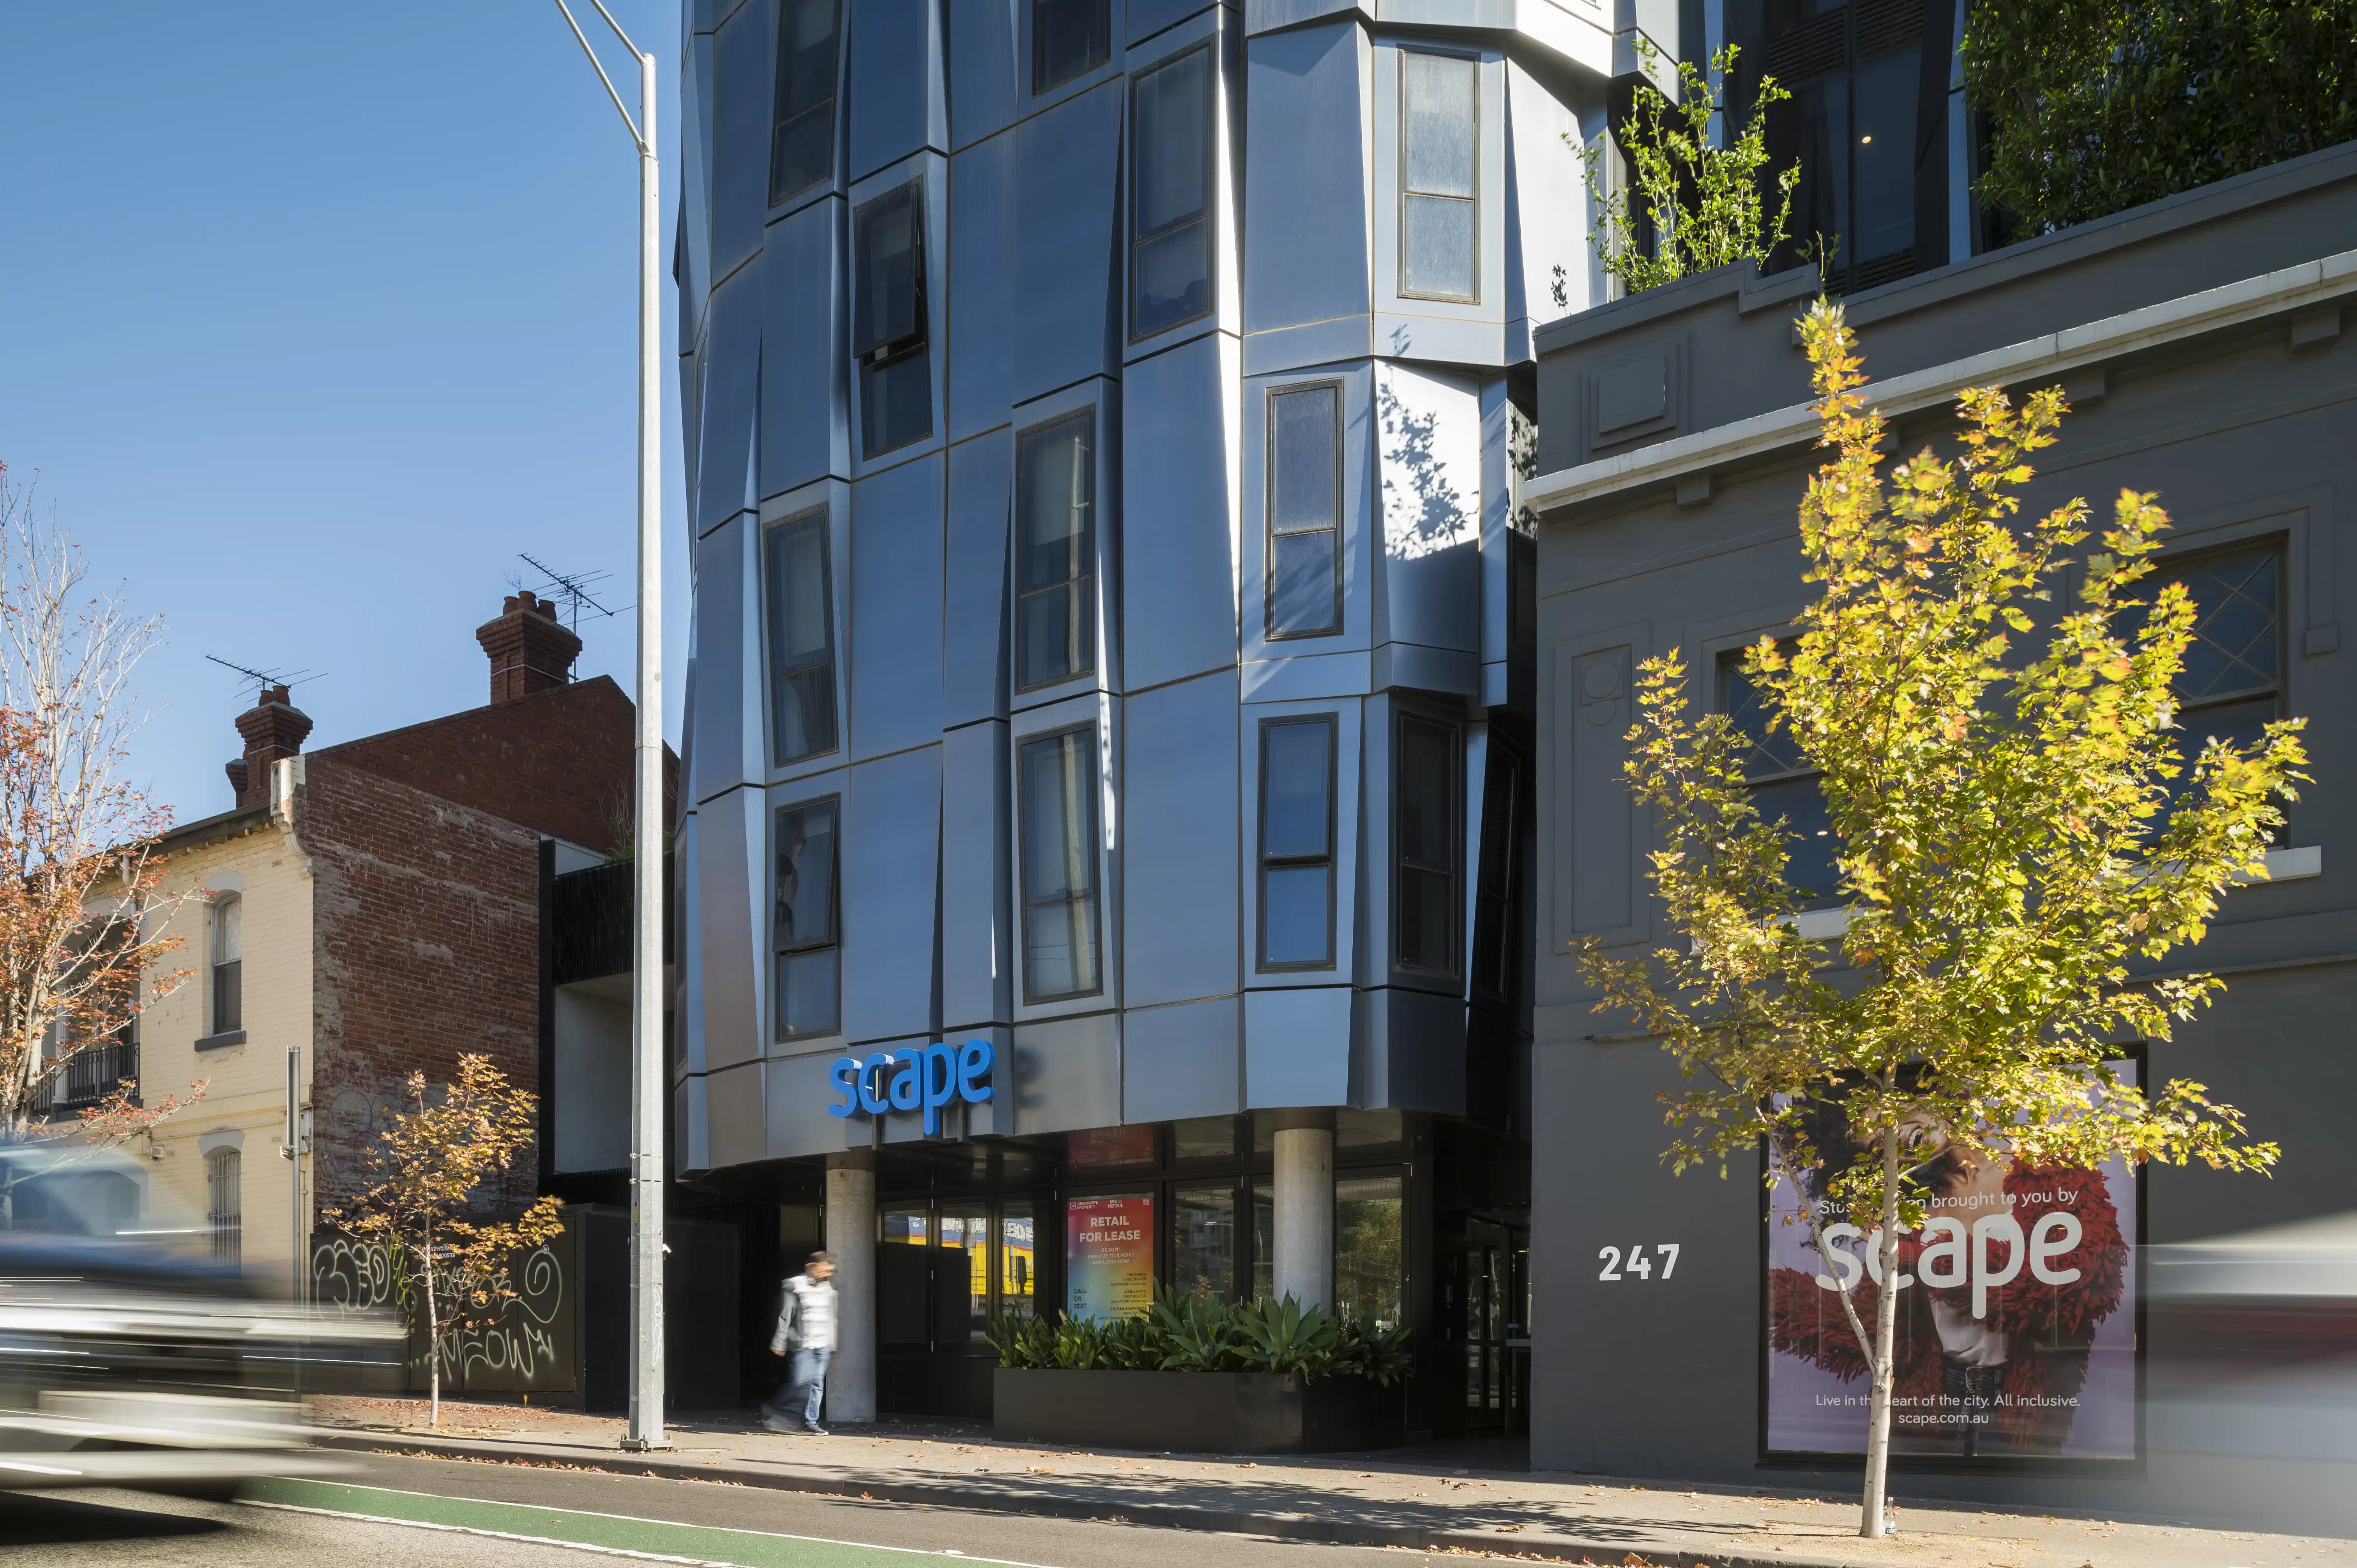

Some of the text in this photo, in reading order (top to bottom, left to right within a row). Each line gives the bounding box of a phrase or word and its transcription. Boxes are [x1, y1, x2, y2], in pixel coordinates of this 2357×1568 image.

[828, 1038, 996, 1135] scape
[1932, 1191, 1995, 1209] brought
[2000, 1192, 2017, 1204] to
[2022, 1191, 2052, 1207] you
[2058, 1187, 2078, 1204] by
[1091, 1216, 1129, 1227] RETAIL
[1080, 1230, 1140, 1242] FOR LEASE
[1599, 1244, 1679, 1280] 247
[1815, 1211, 2082, 1319] scape
[1816, 1394, 2080, 1409] Live in th eart of the city. All inclusive.
[1898, 1414, 1989, 1426] scape.com.au
